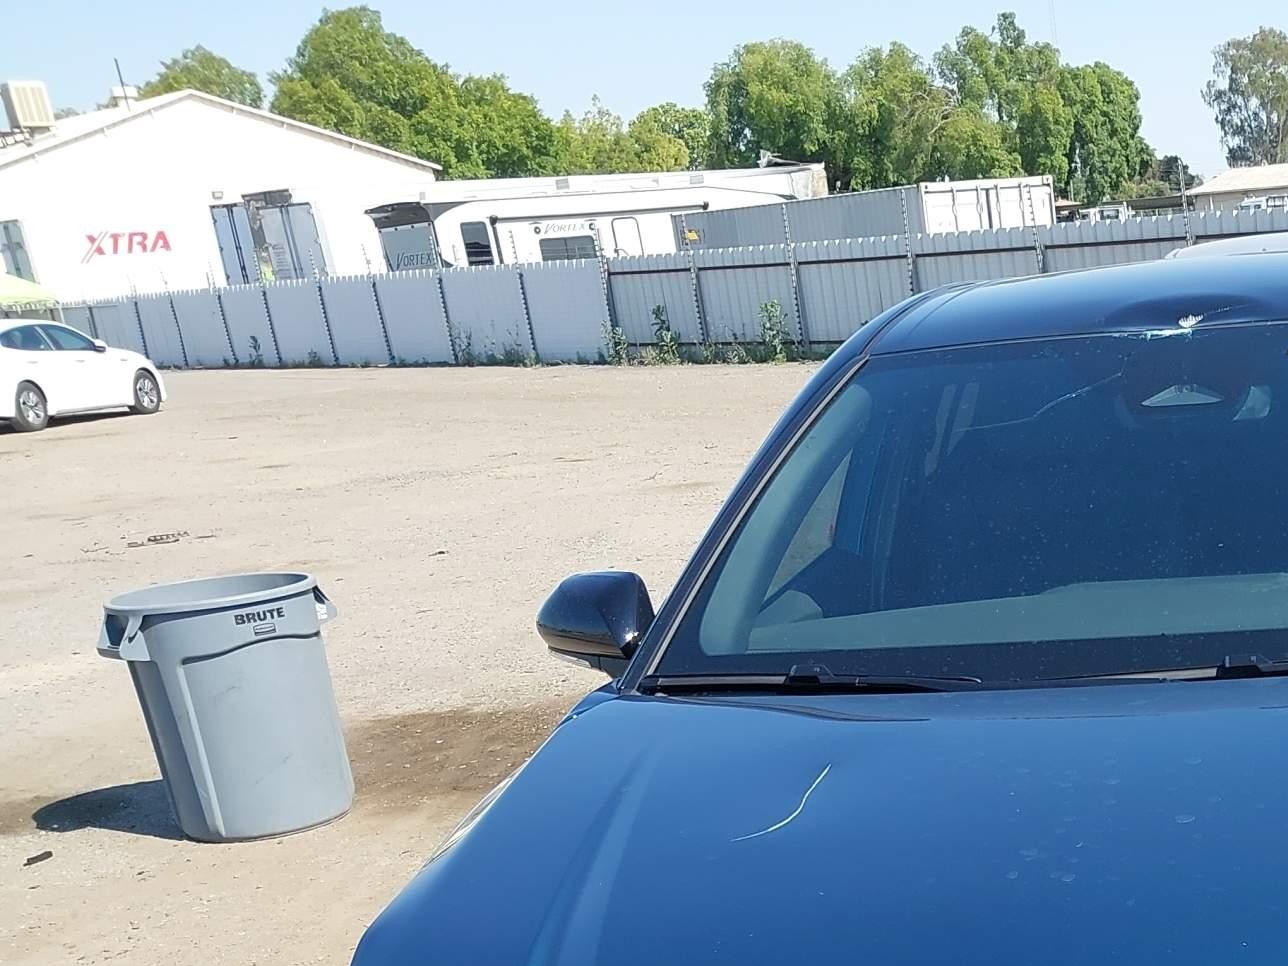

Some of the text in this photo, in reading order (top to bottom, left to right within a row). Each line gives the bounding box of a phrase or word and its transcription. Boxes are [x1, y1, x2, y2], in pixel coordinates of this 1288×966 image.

[81, 231, 172, 264] XTRA
[396, 252, 433, 271] VORTEX
[233, 606, 286, 626] BRUTE
